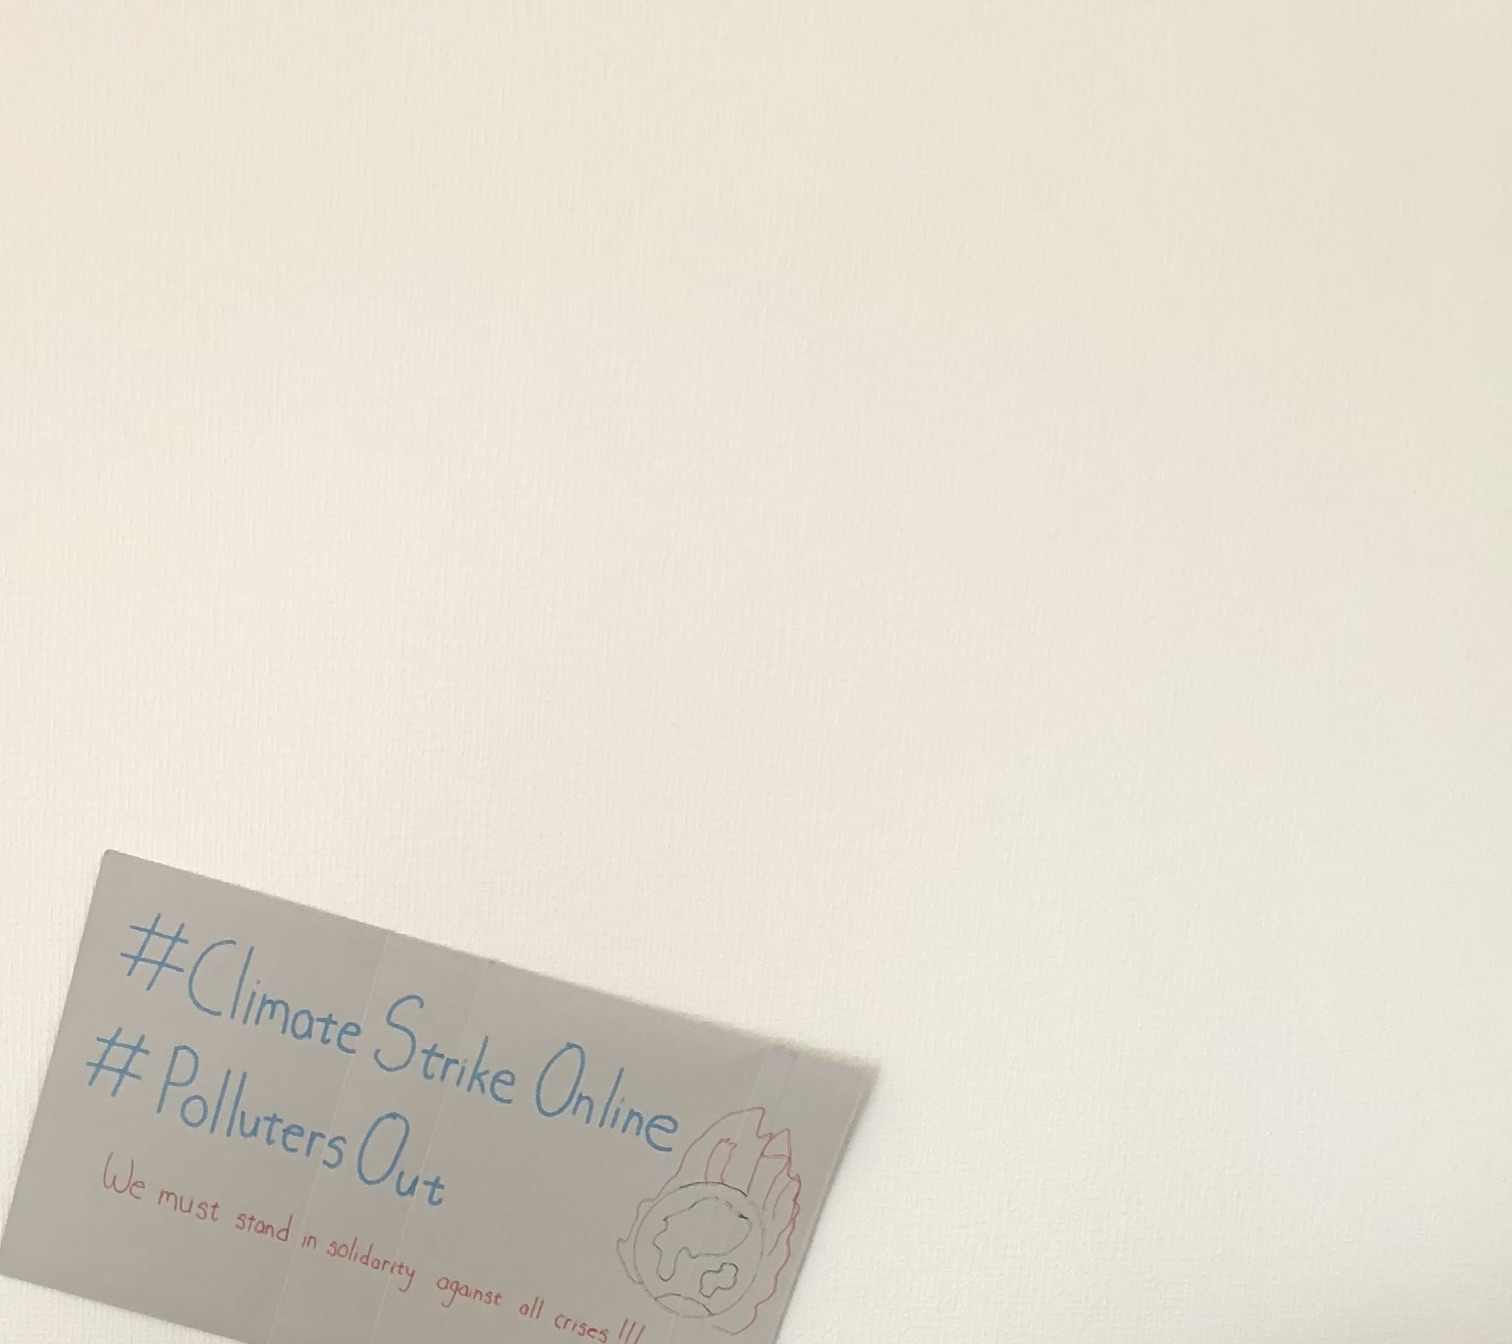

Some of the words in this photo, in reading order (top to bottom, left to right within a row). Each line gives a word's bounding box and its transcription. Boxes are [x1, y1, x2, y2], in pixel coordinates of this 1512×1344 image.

[119, 911, 363, 1055] #Climate
[373, 994, 516, 1105] Strike
[535, 1040, 679, 1153] Online
[102, 1150, 146, 1200] We
[157, 1188, 220, 1222] must
[234, 1213, 294, 1243] stand
[300, 1231, 318, 1250] in
[325, 1236, 417, 1293] solidarity
[435, 1276, 503, 1309] against
[518, 1296, 545, 1321] all
[356, 1111, 446, 1207] Out
